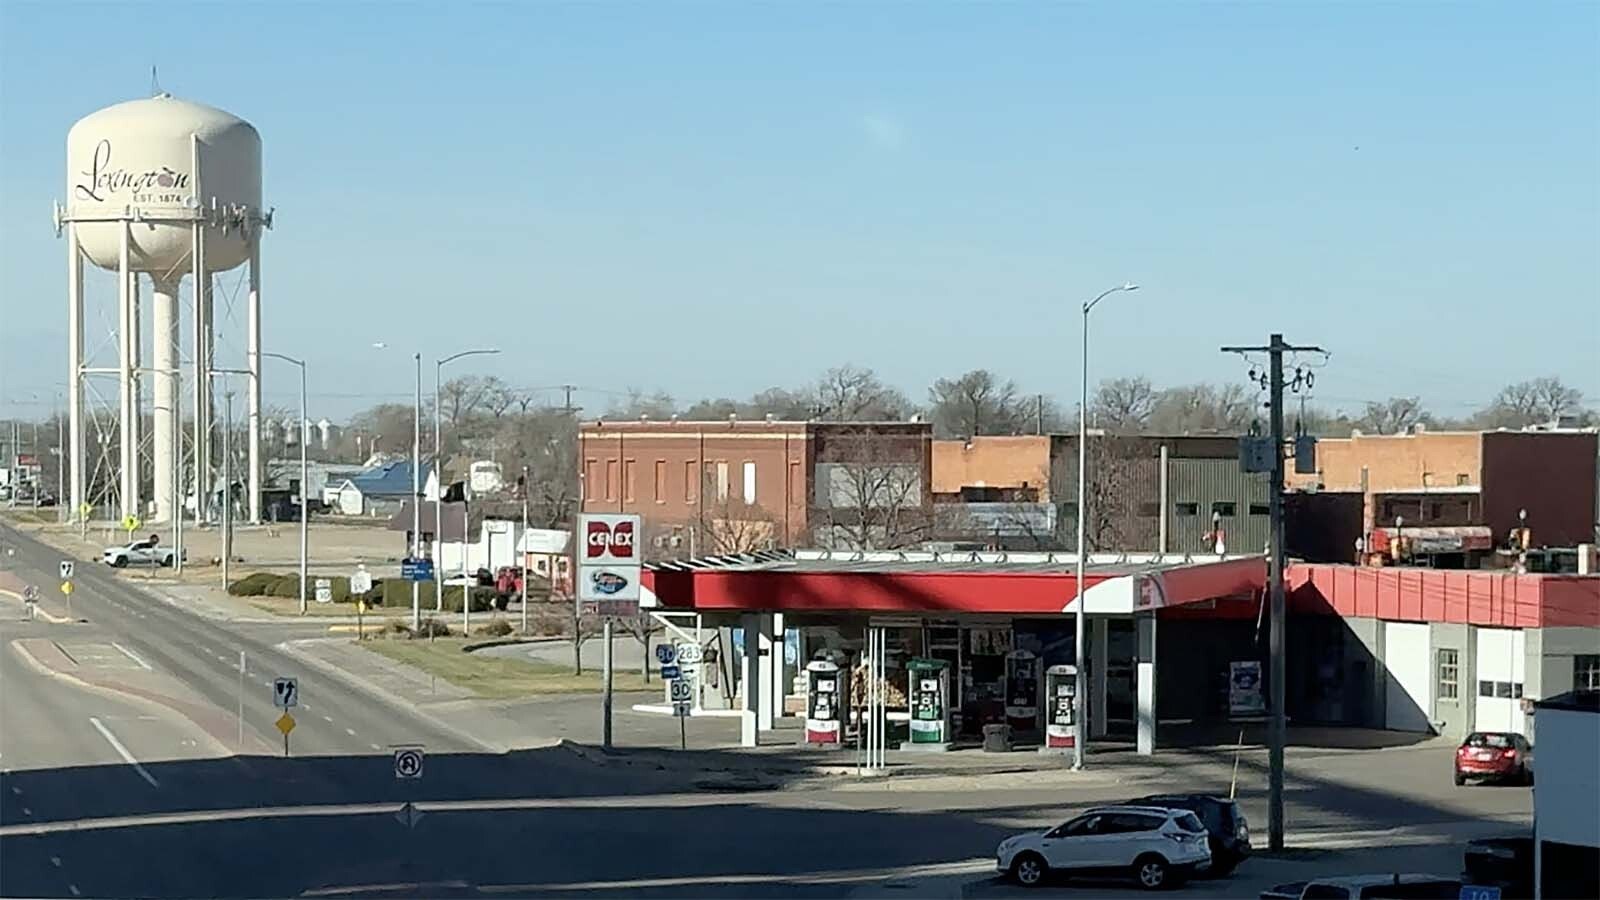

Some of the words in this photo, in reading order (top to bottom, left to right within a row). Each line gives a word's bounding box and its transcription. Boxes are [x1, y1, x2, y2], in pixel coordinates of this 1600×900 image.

[75, 139, 189, 202] Lexington
[159, 194, 182, 203] 1874
[588, 531, 633, 546] CENEX
[679, 646, 700, 660] 283
[672, 683, 689, 697] 30
